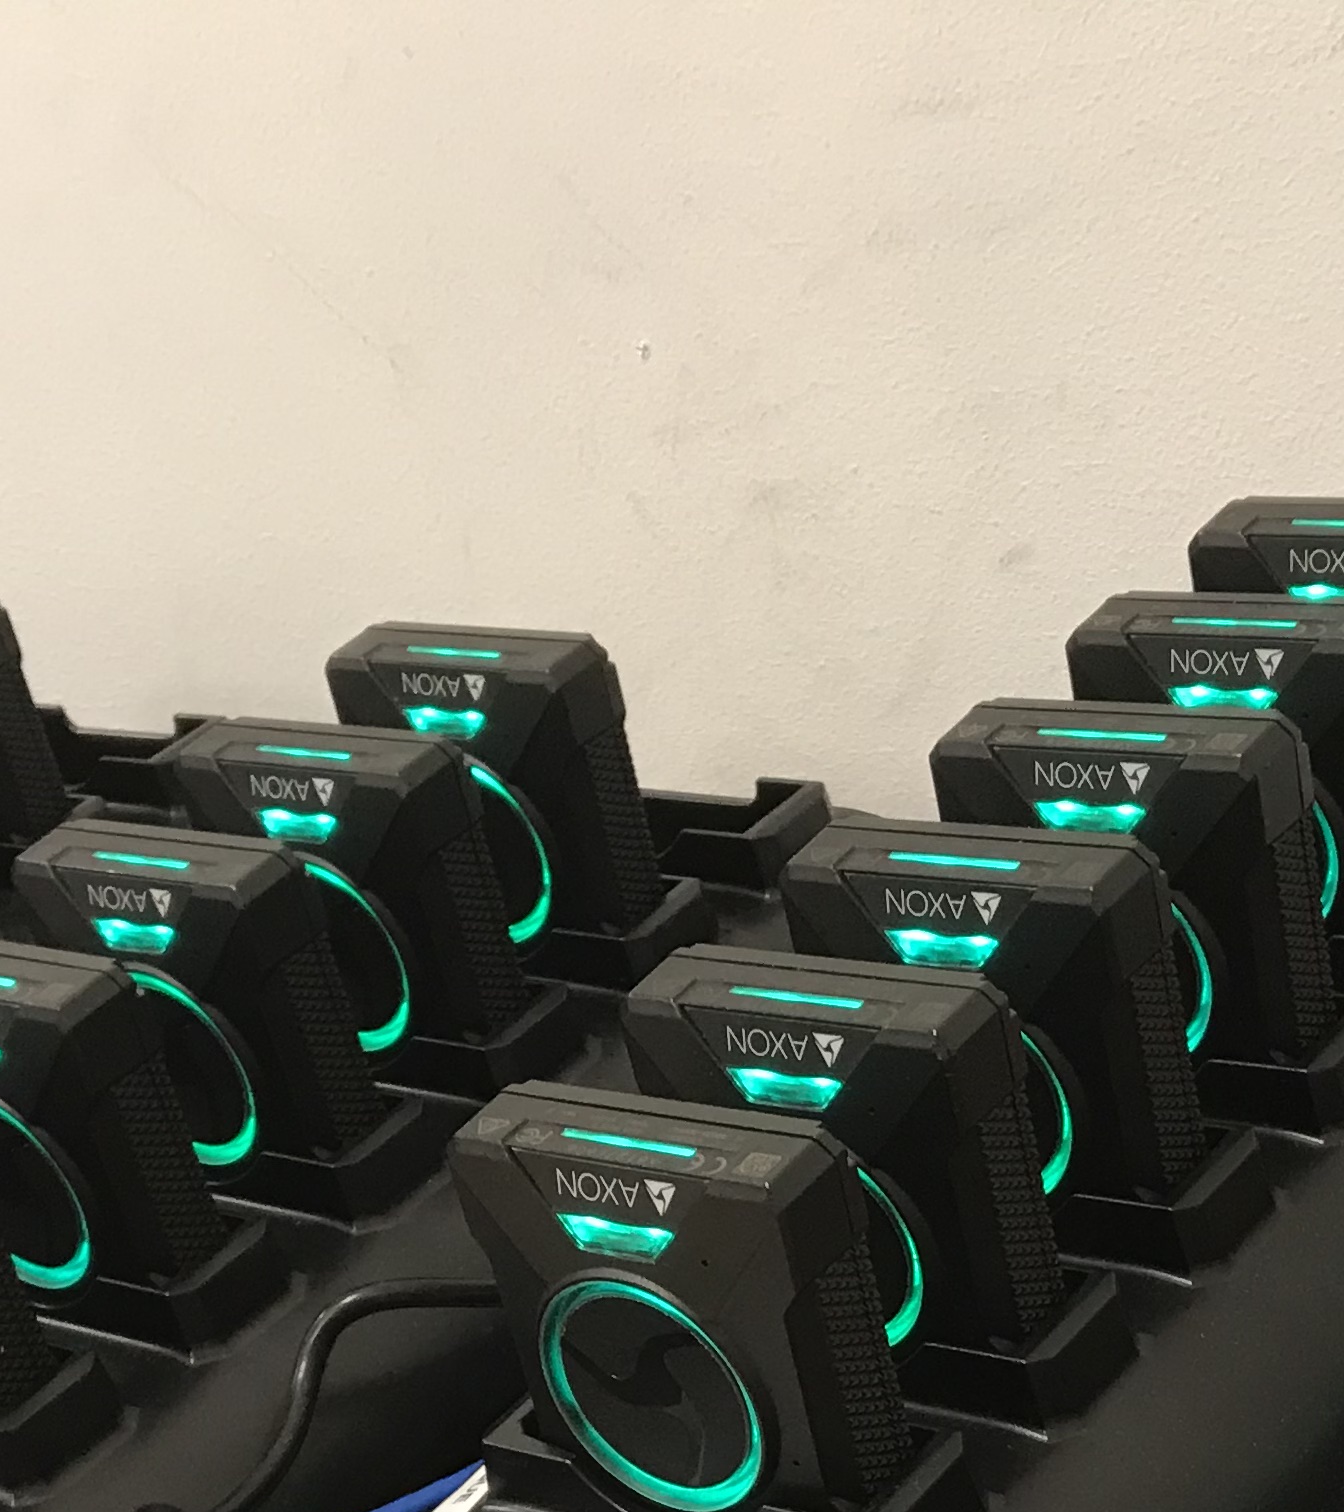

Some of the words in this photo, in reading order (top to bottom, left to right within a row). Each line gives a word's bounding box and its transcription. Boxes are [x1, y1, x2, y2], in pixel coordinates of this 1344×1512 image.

[1170, 648, 1250, 678] AXON
[402, 671, 460, 697] AXON
[251, 773, 309, 801] AXON
[1035, 760, 1115, 790] AXON
[87, 883, 146, 912] AXON
[886, 888, 966, 921] AXON
[726, 1025, 808, 1063] AXON
[556, 1168, 640, 1207] AXON
